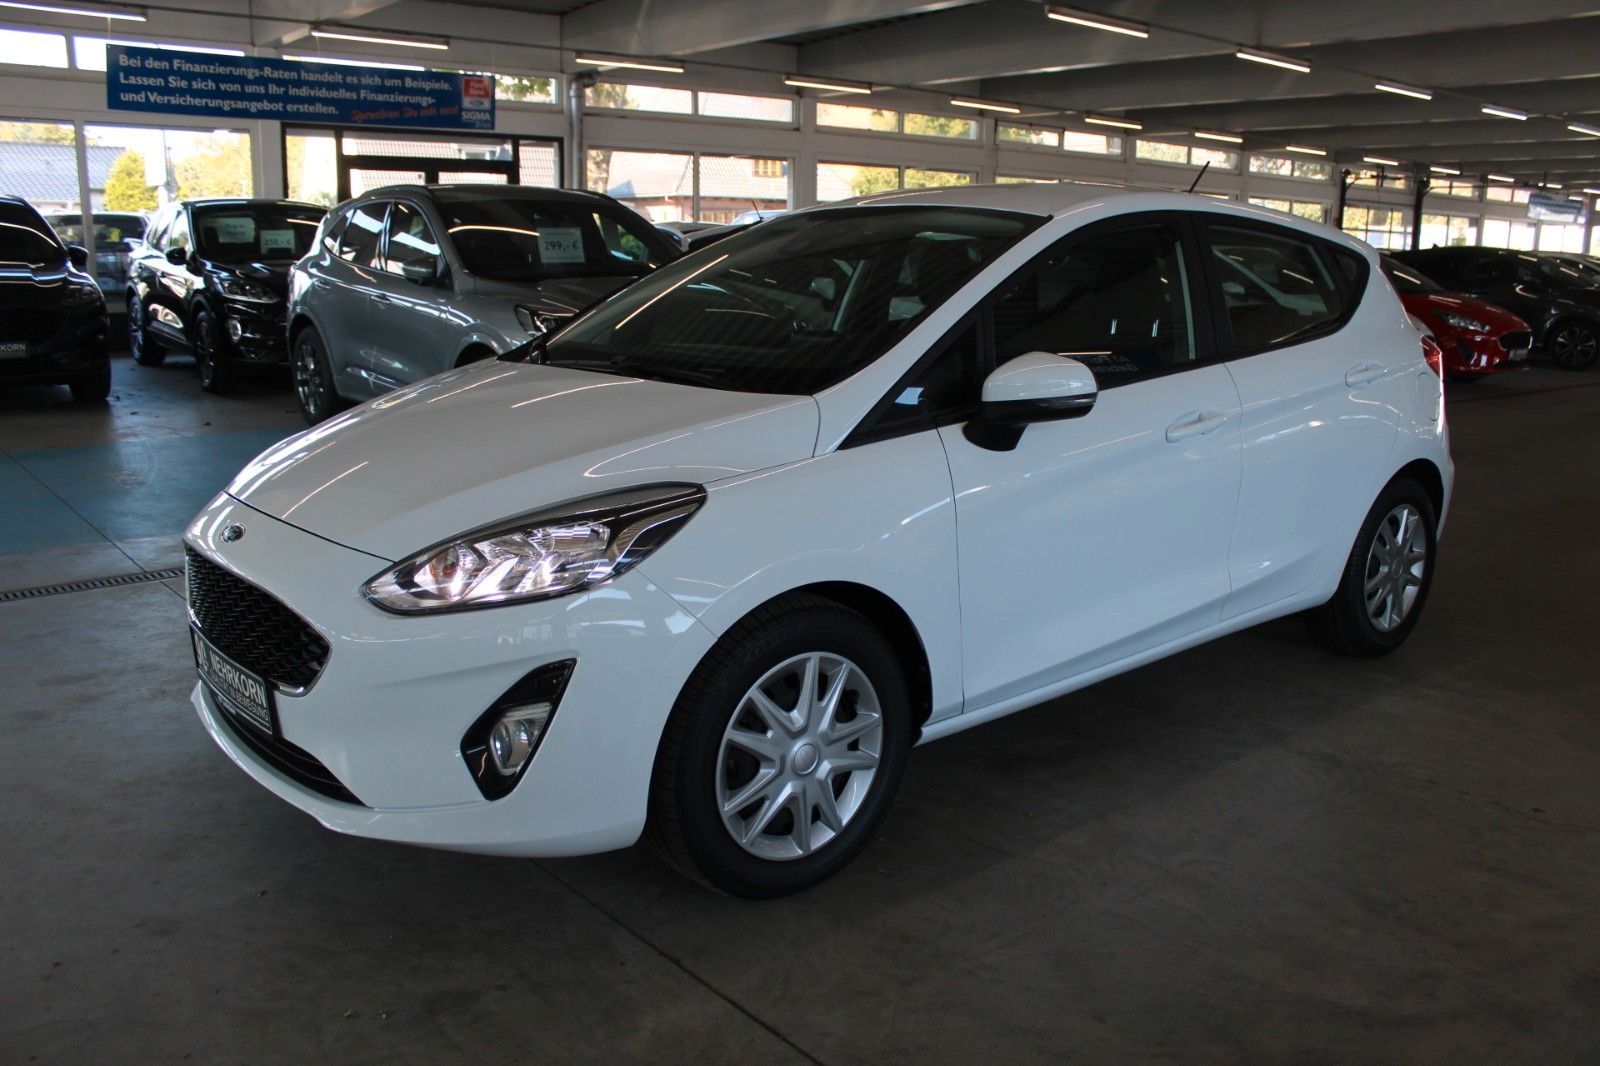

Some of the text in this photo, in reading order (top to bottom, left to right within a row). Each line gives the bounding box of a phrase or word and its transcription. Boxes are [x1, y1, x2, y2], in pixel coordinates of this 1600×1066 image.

[119, 54, 453, 92] Bei den Finanzierungs-Raten handelt es sich um Beispiele.
[119, 72, 437, 107] Lassen Sie sich von uns Ihr individuelles Finanzierungs-
[120, 91, 340, 115] und Versicherungsangebot erstellen.
[461, 111, 490, 121] SIGMA
[209, 649, 267, 708] NEHRKORN
